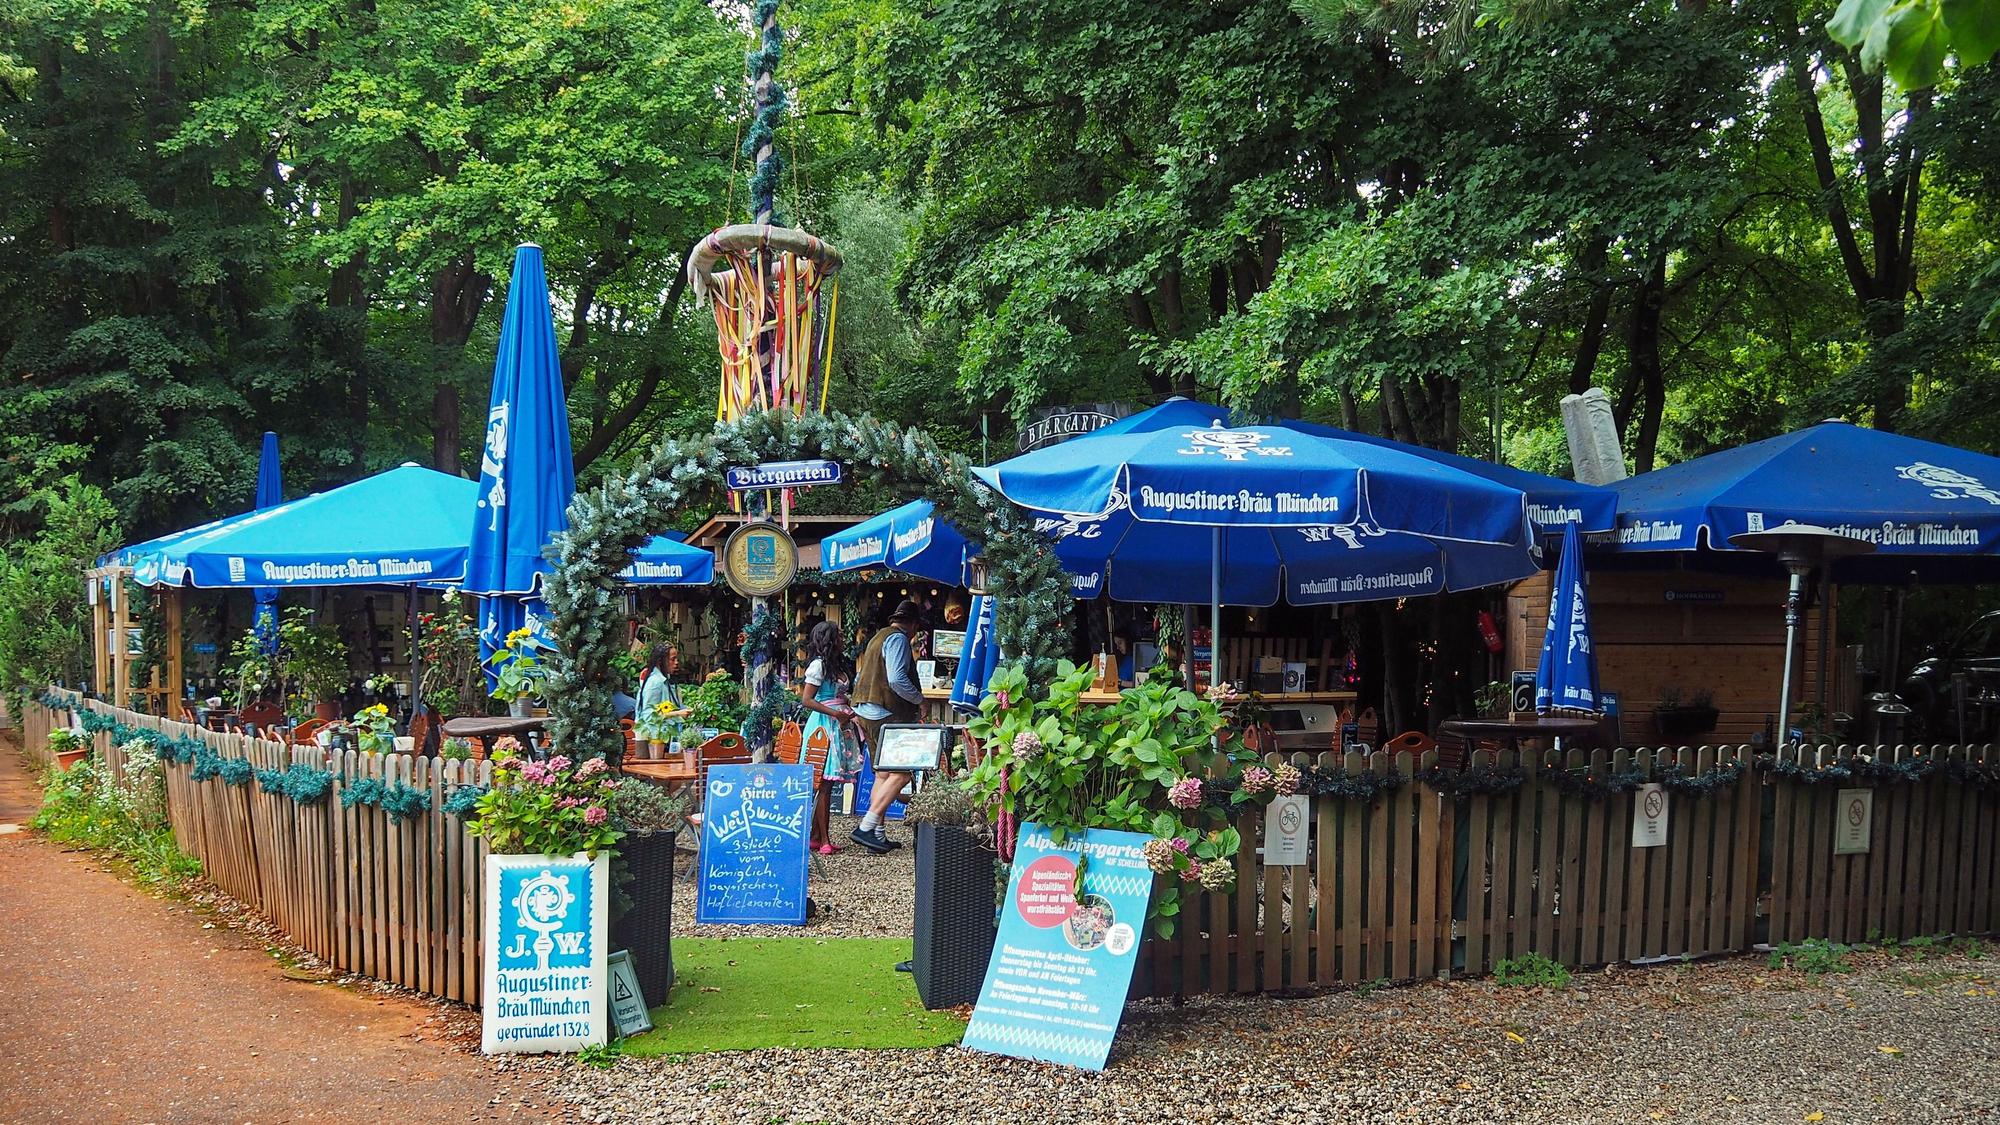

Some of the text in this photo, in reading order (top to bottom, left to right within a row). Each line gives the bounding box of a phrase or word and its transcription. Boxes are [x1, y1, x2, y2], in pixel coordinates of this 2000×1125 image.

[1028, 414, 1114, 444] BIERGARTE
[735, 466, 832, 486] Biergarten
[1275, 492, 1339, 513] München
[1918, 523, 1980, 546] München
[378, 558, 433, 576] München
[634, 561, 683, 578] München
[740, 786, 777, 800] Hirter
[739, 855, 765, 863] vom
[707, 889, 794, 913] Hoflieferanten
[1049, 894, 1060, 903] und
[505, 932, 586, 959] J. W.
[1028, 969, 1040, 979] und
[1033, 960, 1043, 968] bis
[1043, 961, 1067, 973] Sonntag
[1067, 965, 1076, 973] ab
[1077, 965, 1085, 974] 12
[497, 996, 591, 1019] Bräu München
[497, 1021, 591, 1043] gegründet 1328
